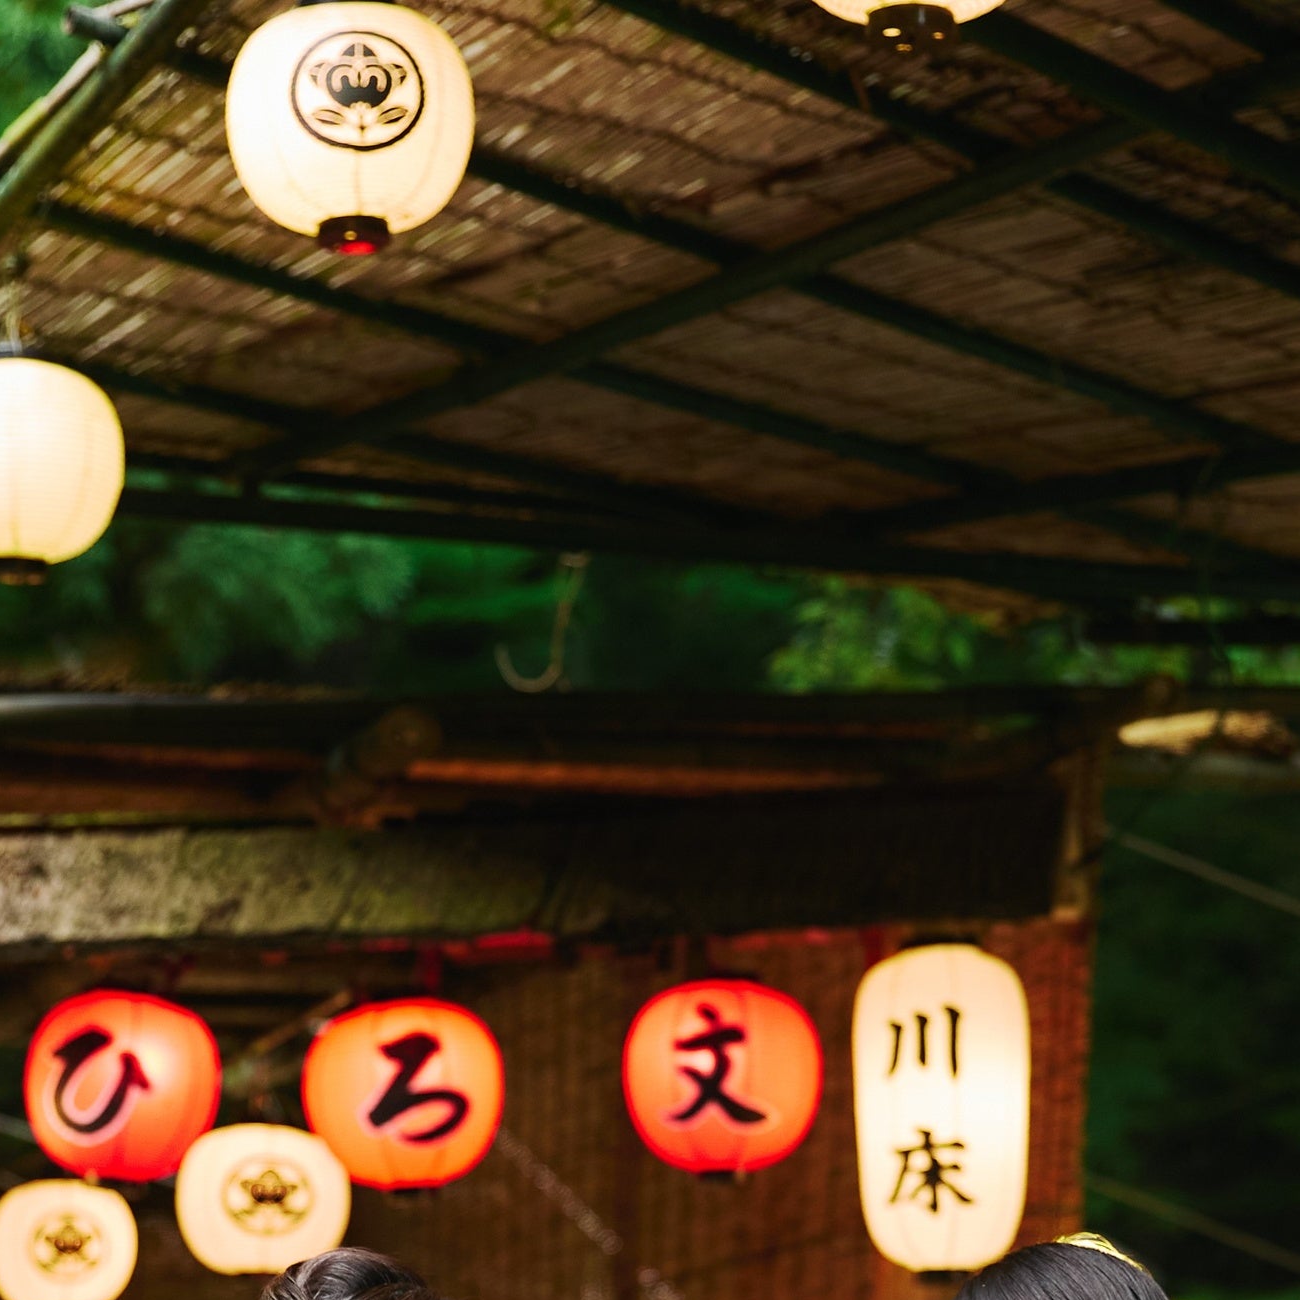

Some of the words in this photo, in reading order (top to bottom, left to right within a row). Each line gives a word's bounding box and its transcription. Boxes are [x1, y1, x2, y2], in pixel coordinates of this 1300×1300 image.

[52, 1025, 153, 1134] ひ
[366, 1031, 471, 1145] ろ
[673, 1003, 768, 1125] 文
[887, 1004, 974, 1214] 川床
